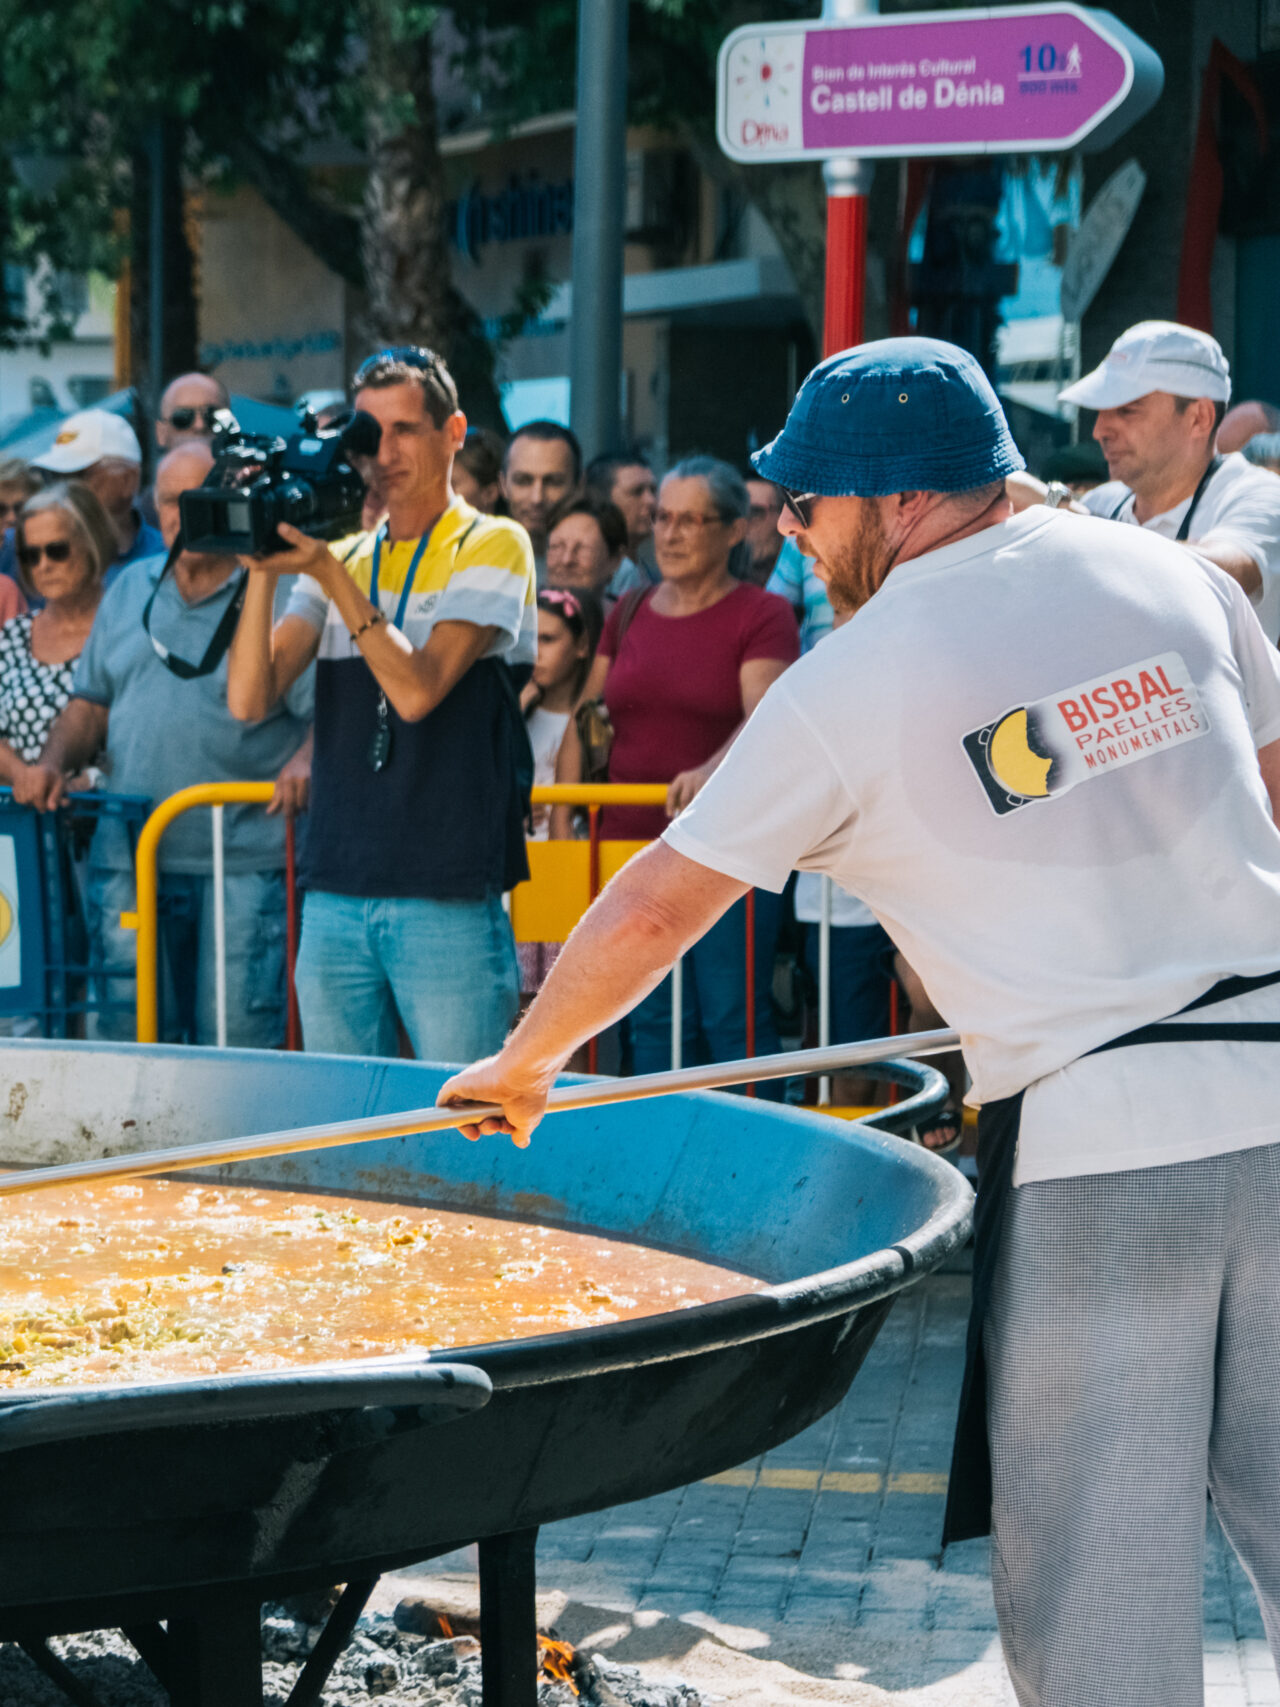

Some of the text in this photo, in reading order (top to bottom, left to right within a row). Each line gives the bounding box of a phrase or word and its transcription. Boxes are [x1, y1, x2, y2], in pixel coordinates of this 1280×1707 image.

[812, 65, 845, 83] Bien
[847, 62, 865, 81] de
[918, 56, 977, 78] Cultural
[1020, 43, 1057, 73] 10
[810, 78, 1005, 114] Castell de Dénia
[1057, 665, 1184, 733] BISBAL
[1075, 697, 1192, 750] PAELLES
[1083, 714, 1200, 769] MONUMENTALS
